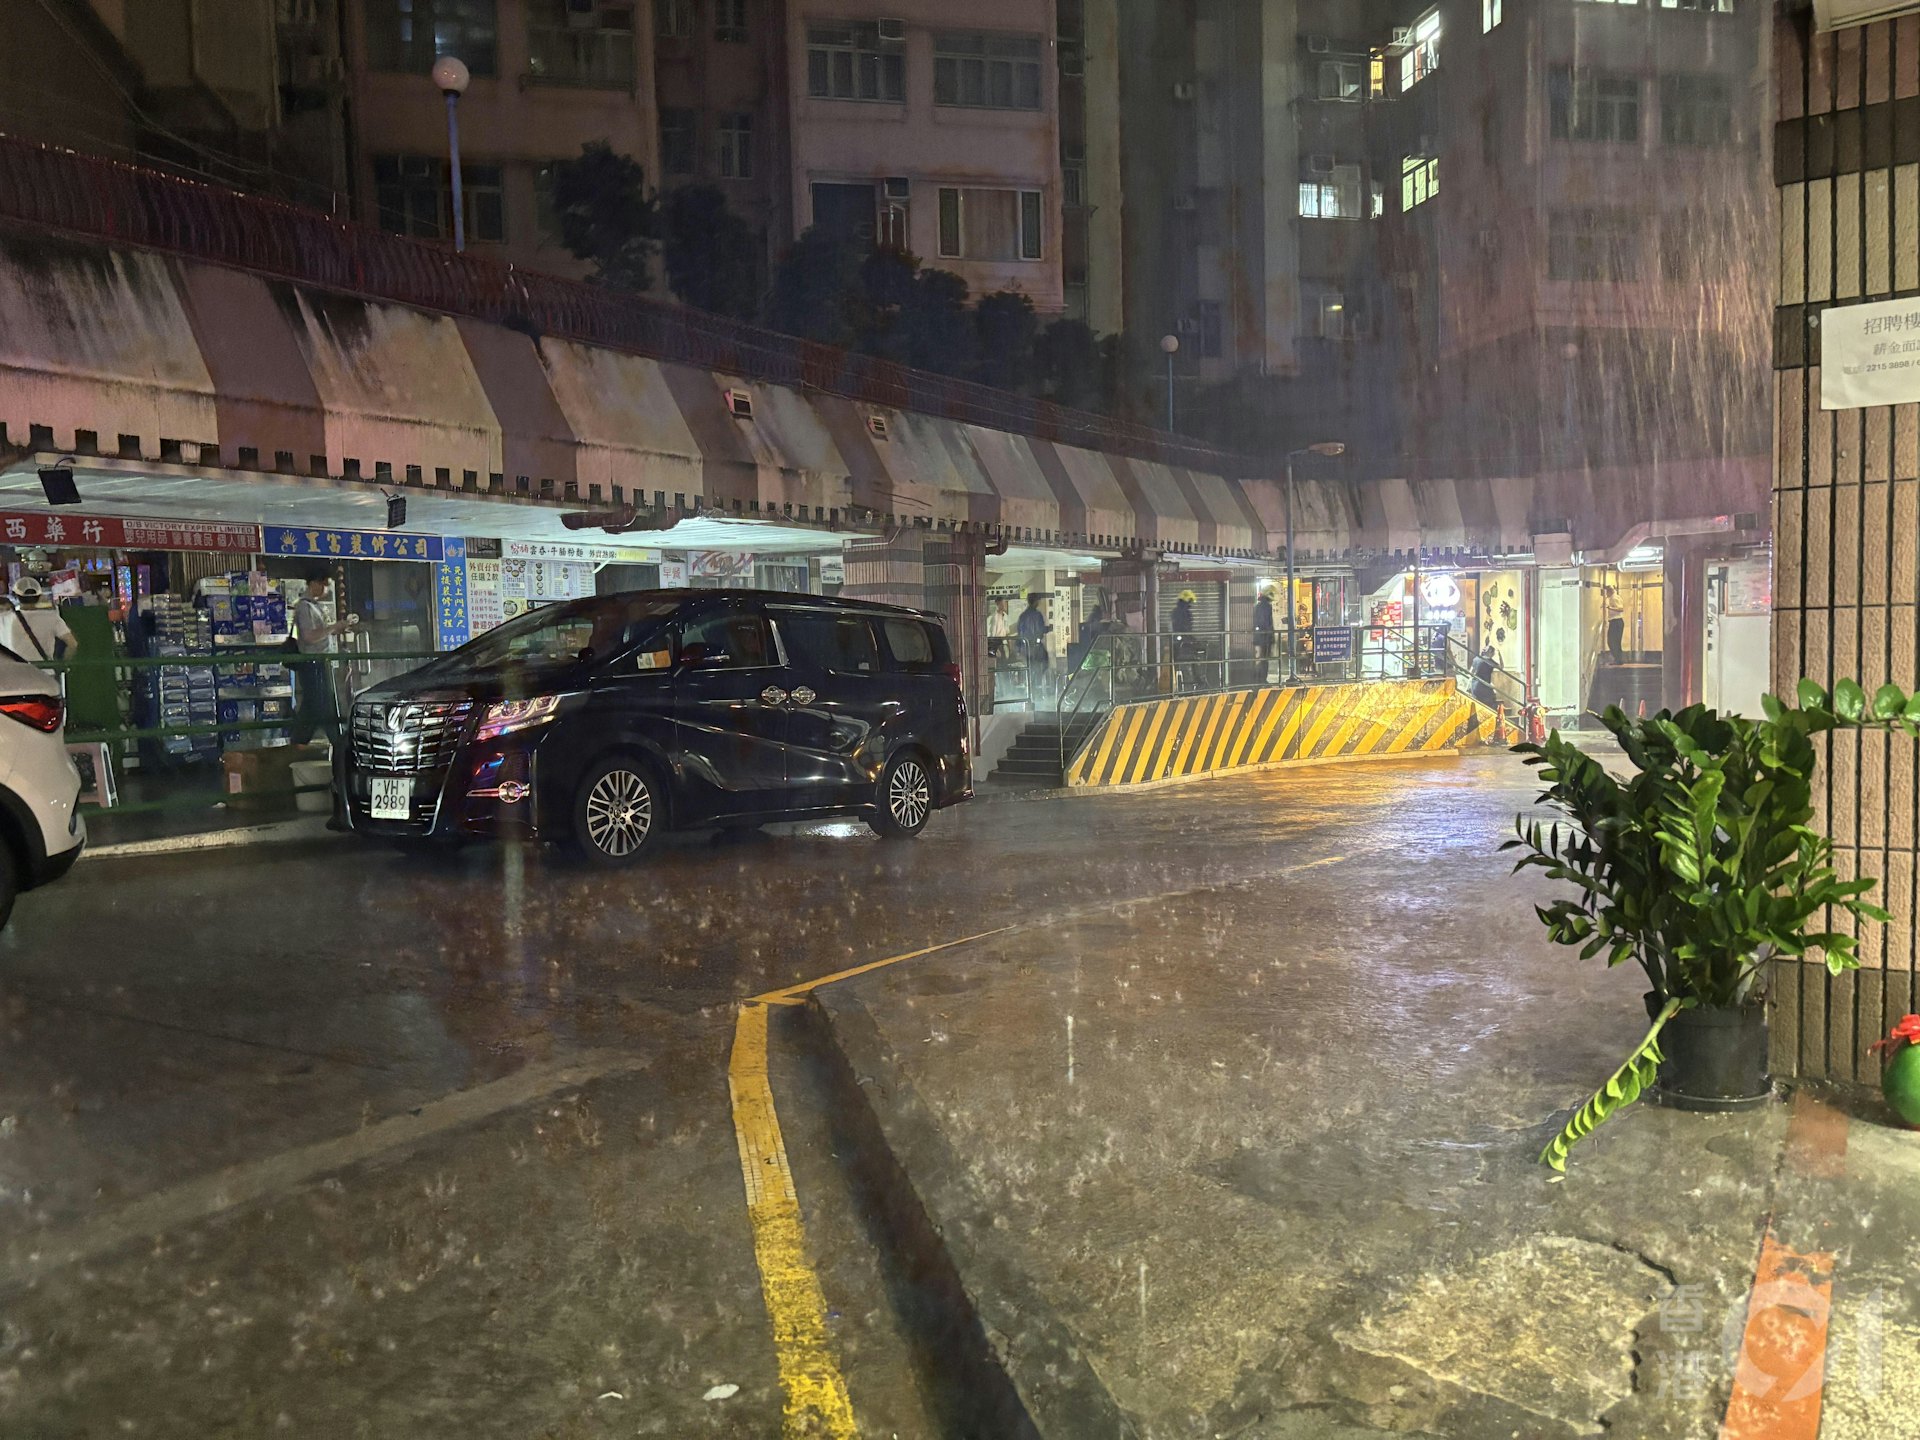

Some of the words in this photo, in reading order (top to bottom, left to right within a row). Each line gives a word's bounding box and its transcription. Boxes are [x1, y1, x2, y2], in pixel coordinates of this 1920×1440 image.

[1873, 339, 1920, 355] 薪金面
[1866, 364, 1887, 372] 2215
[5, 516, 104, 543] 西藥行
[144, 522, 184, 531] VICTORY
[184, 523, 217, 532] EXPERT
[219, 525, 252, 534] LIMITED
[384, 780, 398, 795] VH
[375, 795, 406, 810] 2989
